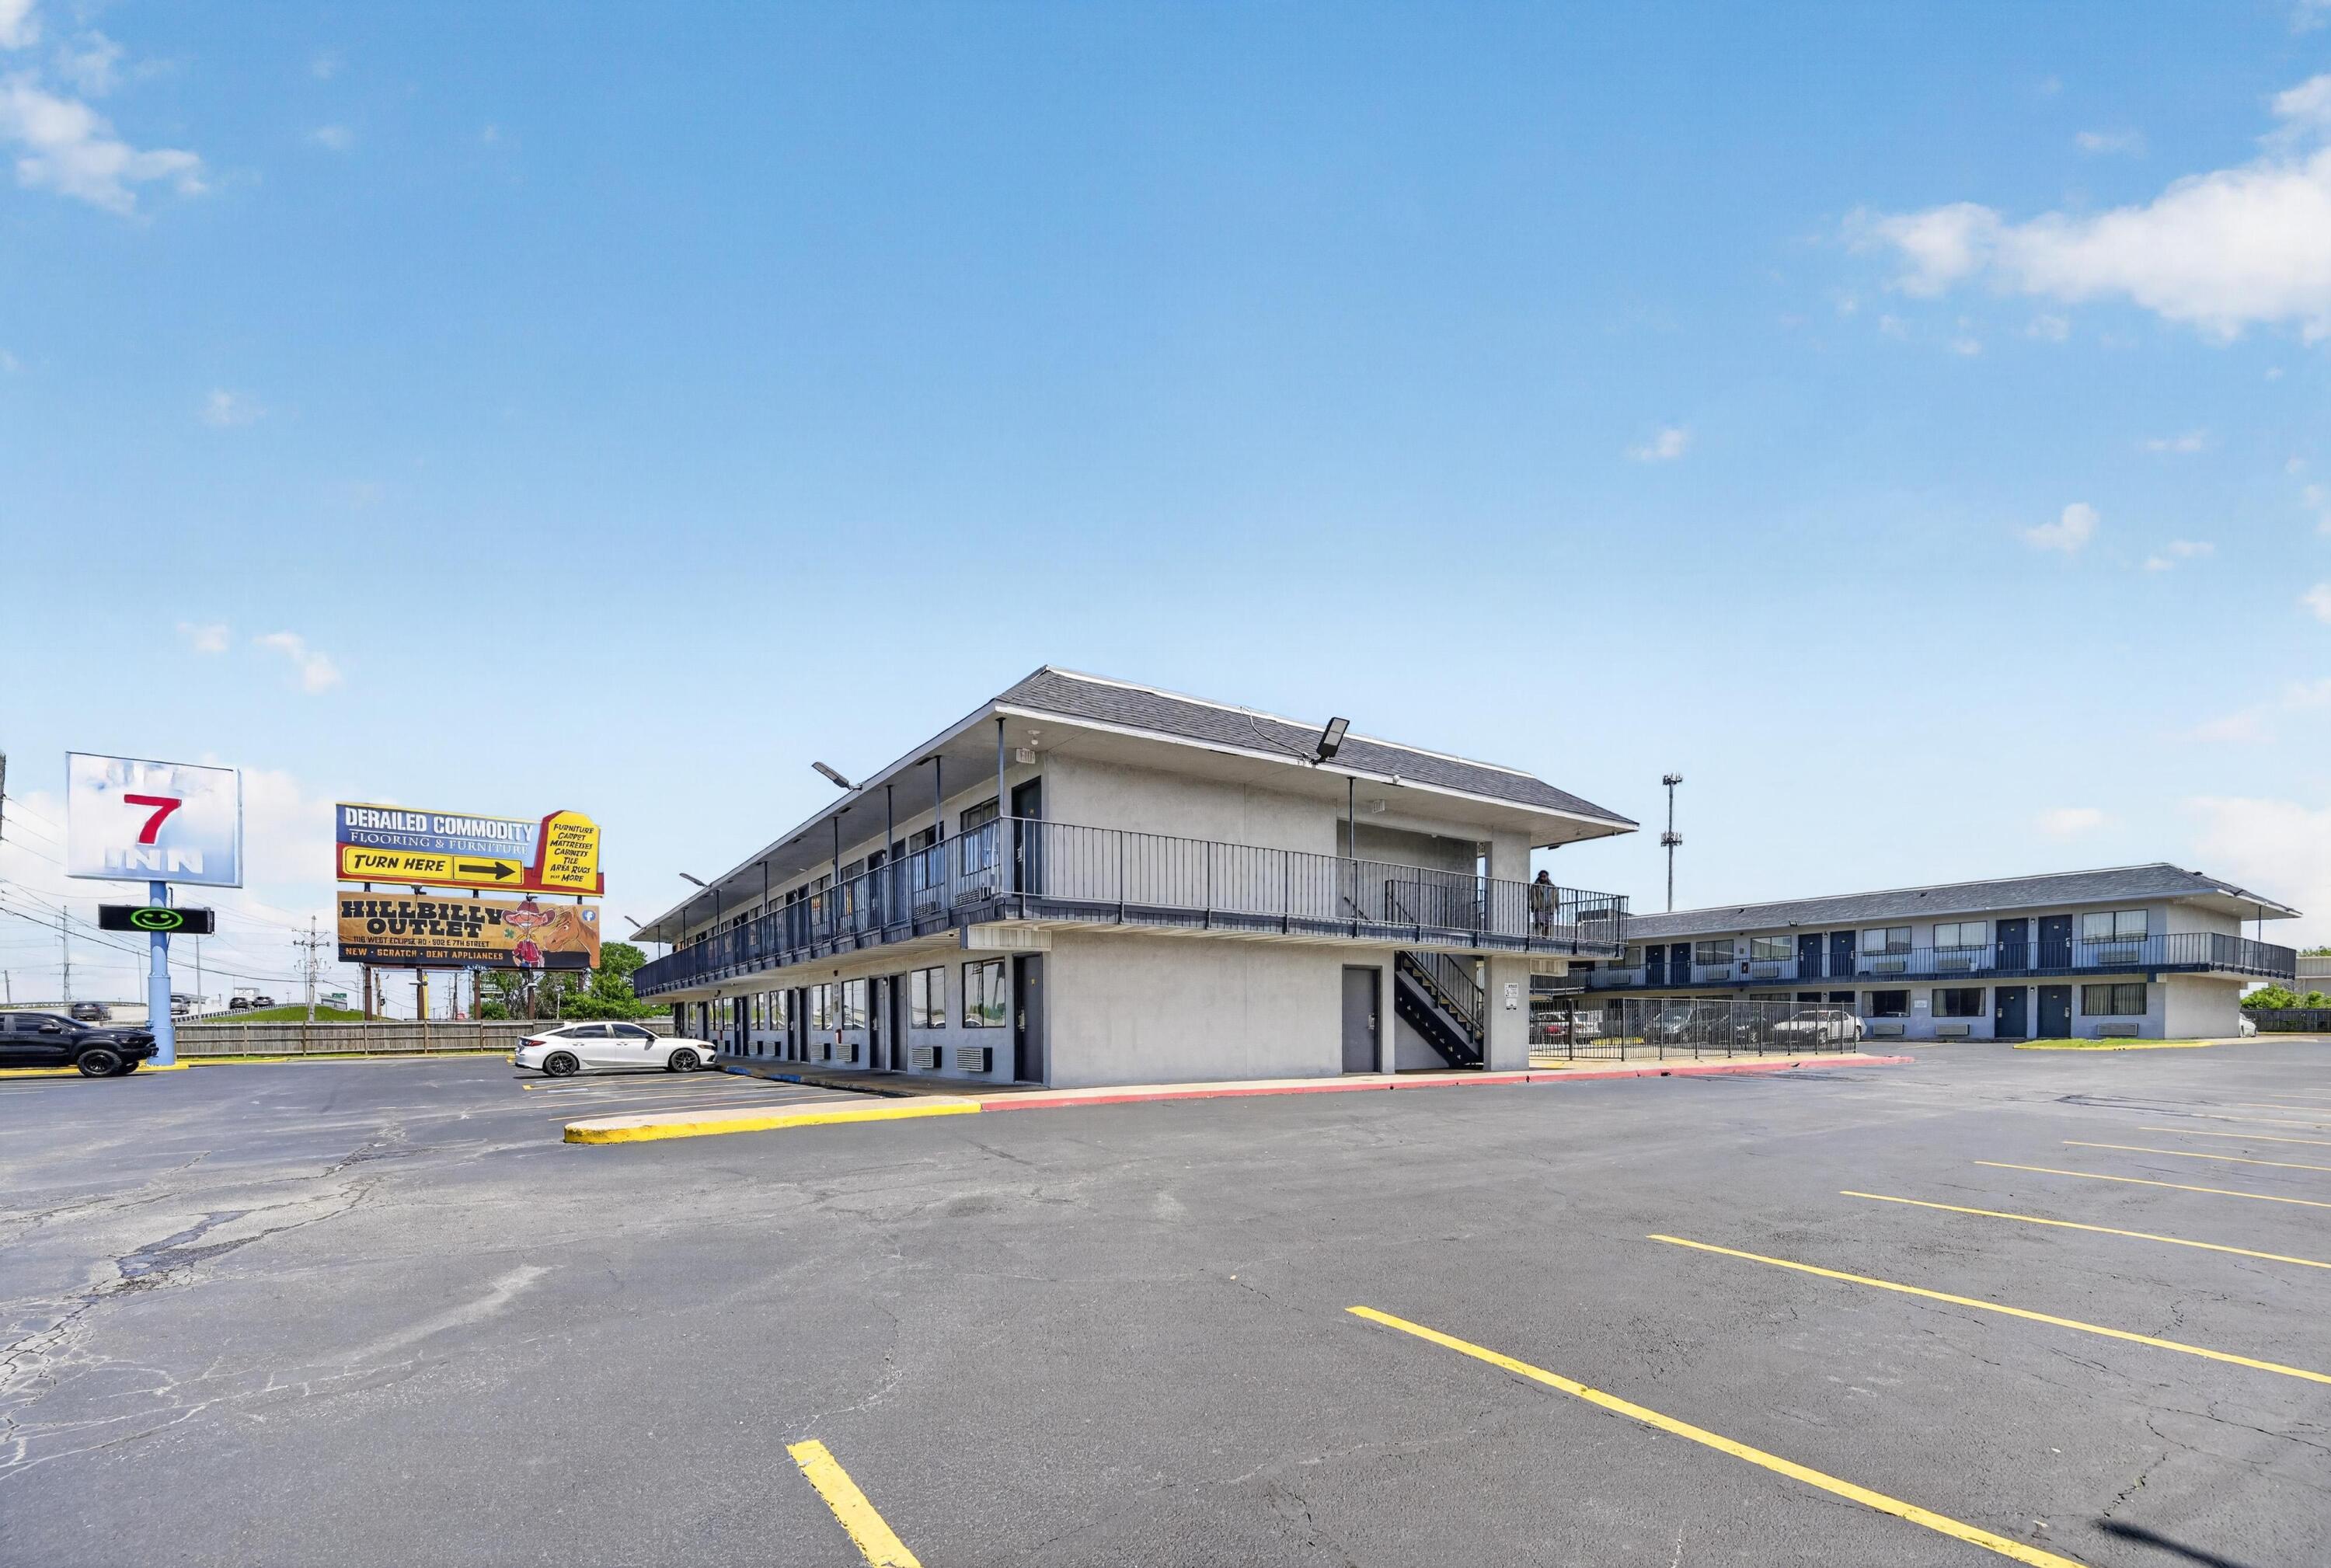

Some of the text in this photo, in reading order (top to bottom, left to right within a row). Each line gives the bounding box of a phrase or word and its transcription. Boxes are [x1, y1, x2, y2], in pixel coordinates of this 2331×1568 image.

[124, 793, 183, 845] 7
[345, 807, 533, 841] DERAILED COMMODITY
[553, 823, 594, 834] FURNITURE
[558, 832, 587, 841] CARPET
[351, 831, 528, 855] FLOORING & FURNITURE
[550, 840, 594, 850] MATTRESSES
[105, 848, 204, 874] INN
[354, 855, 446, 872] TURN HERE
[563, 856, 579, 865] TILE
[571, 866, 591, 874] RUGS
[561, 873, 584, 883] MORE
[341, 901, 503, 925] HILLBILLY
[367, 918, 482, 938] OUTLET
[368, 936, 387, 944] WEST
[377, 949, 417, 957] SCRATCH
[426, 950, 448, 959] DENT
[451, 951, 504, 960] APPLIANCES
